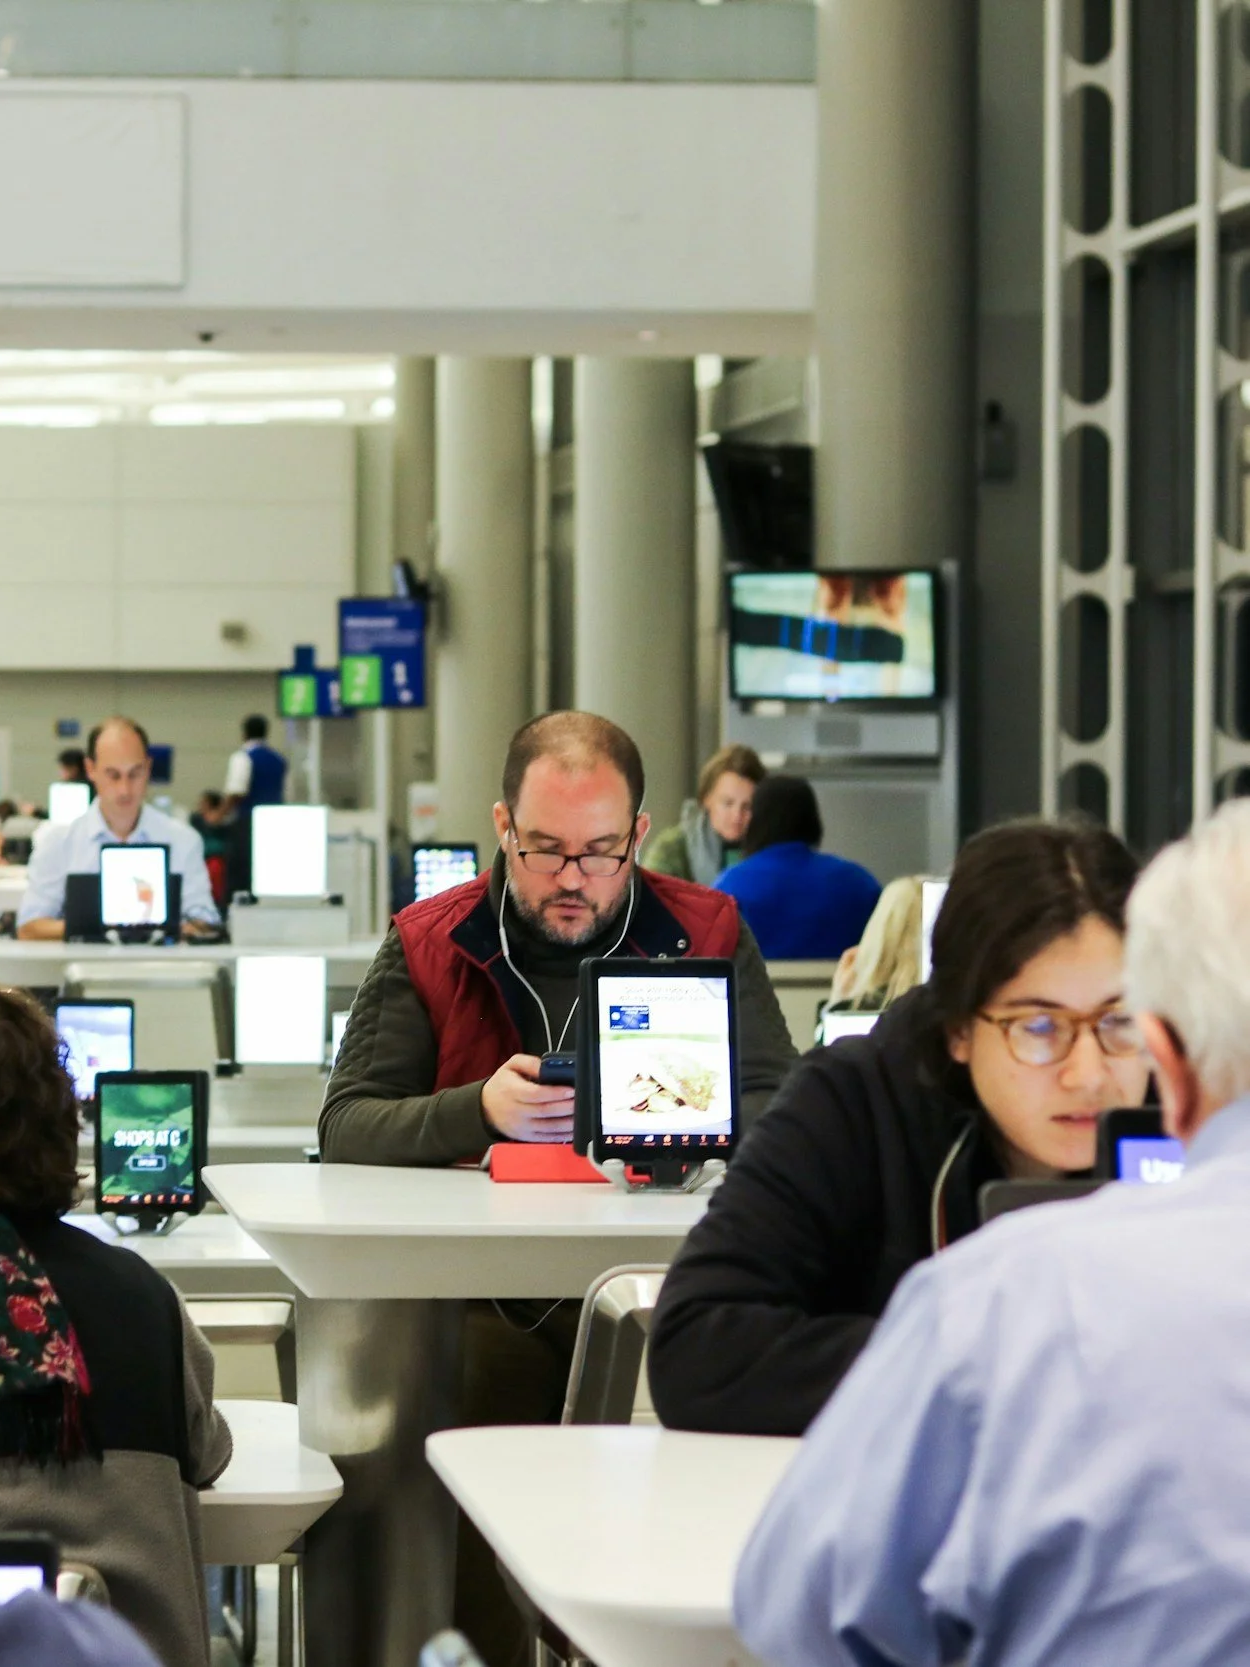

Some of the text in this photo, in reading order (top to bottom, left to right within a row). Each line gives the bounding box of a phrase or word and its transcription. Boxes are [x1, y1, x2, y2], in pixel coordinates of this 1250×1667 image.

[113, 1129, 181, 1148] SHOPS AT C
